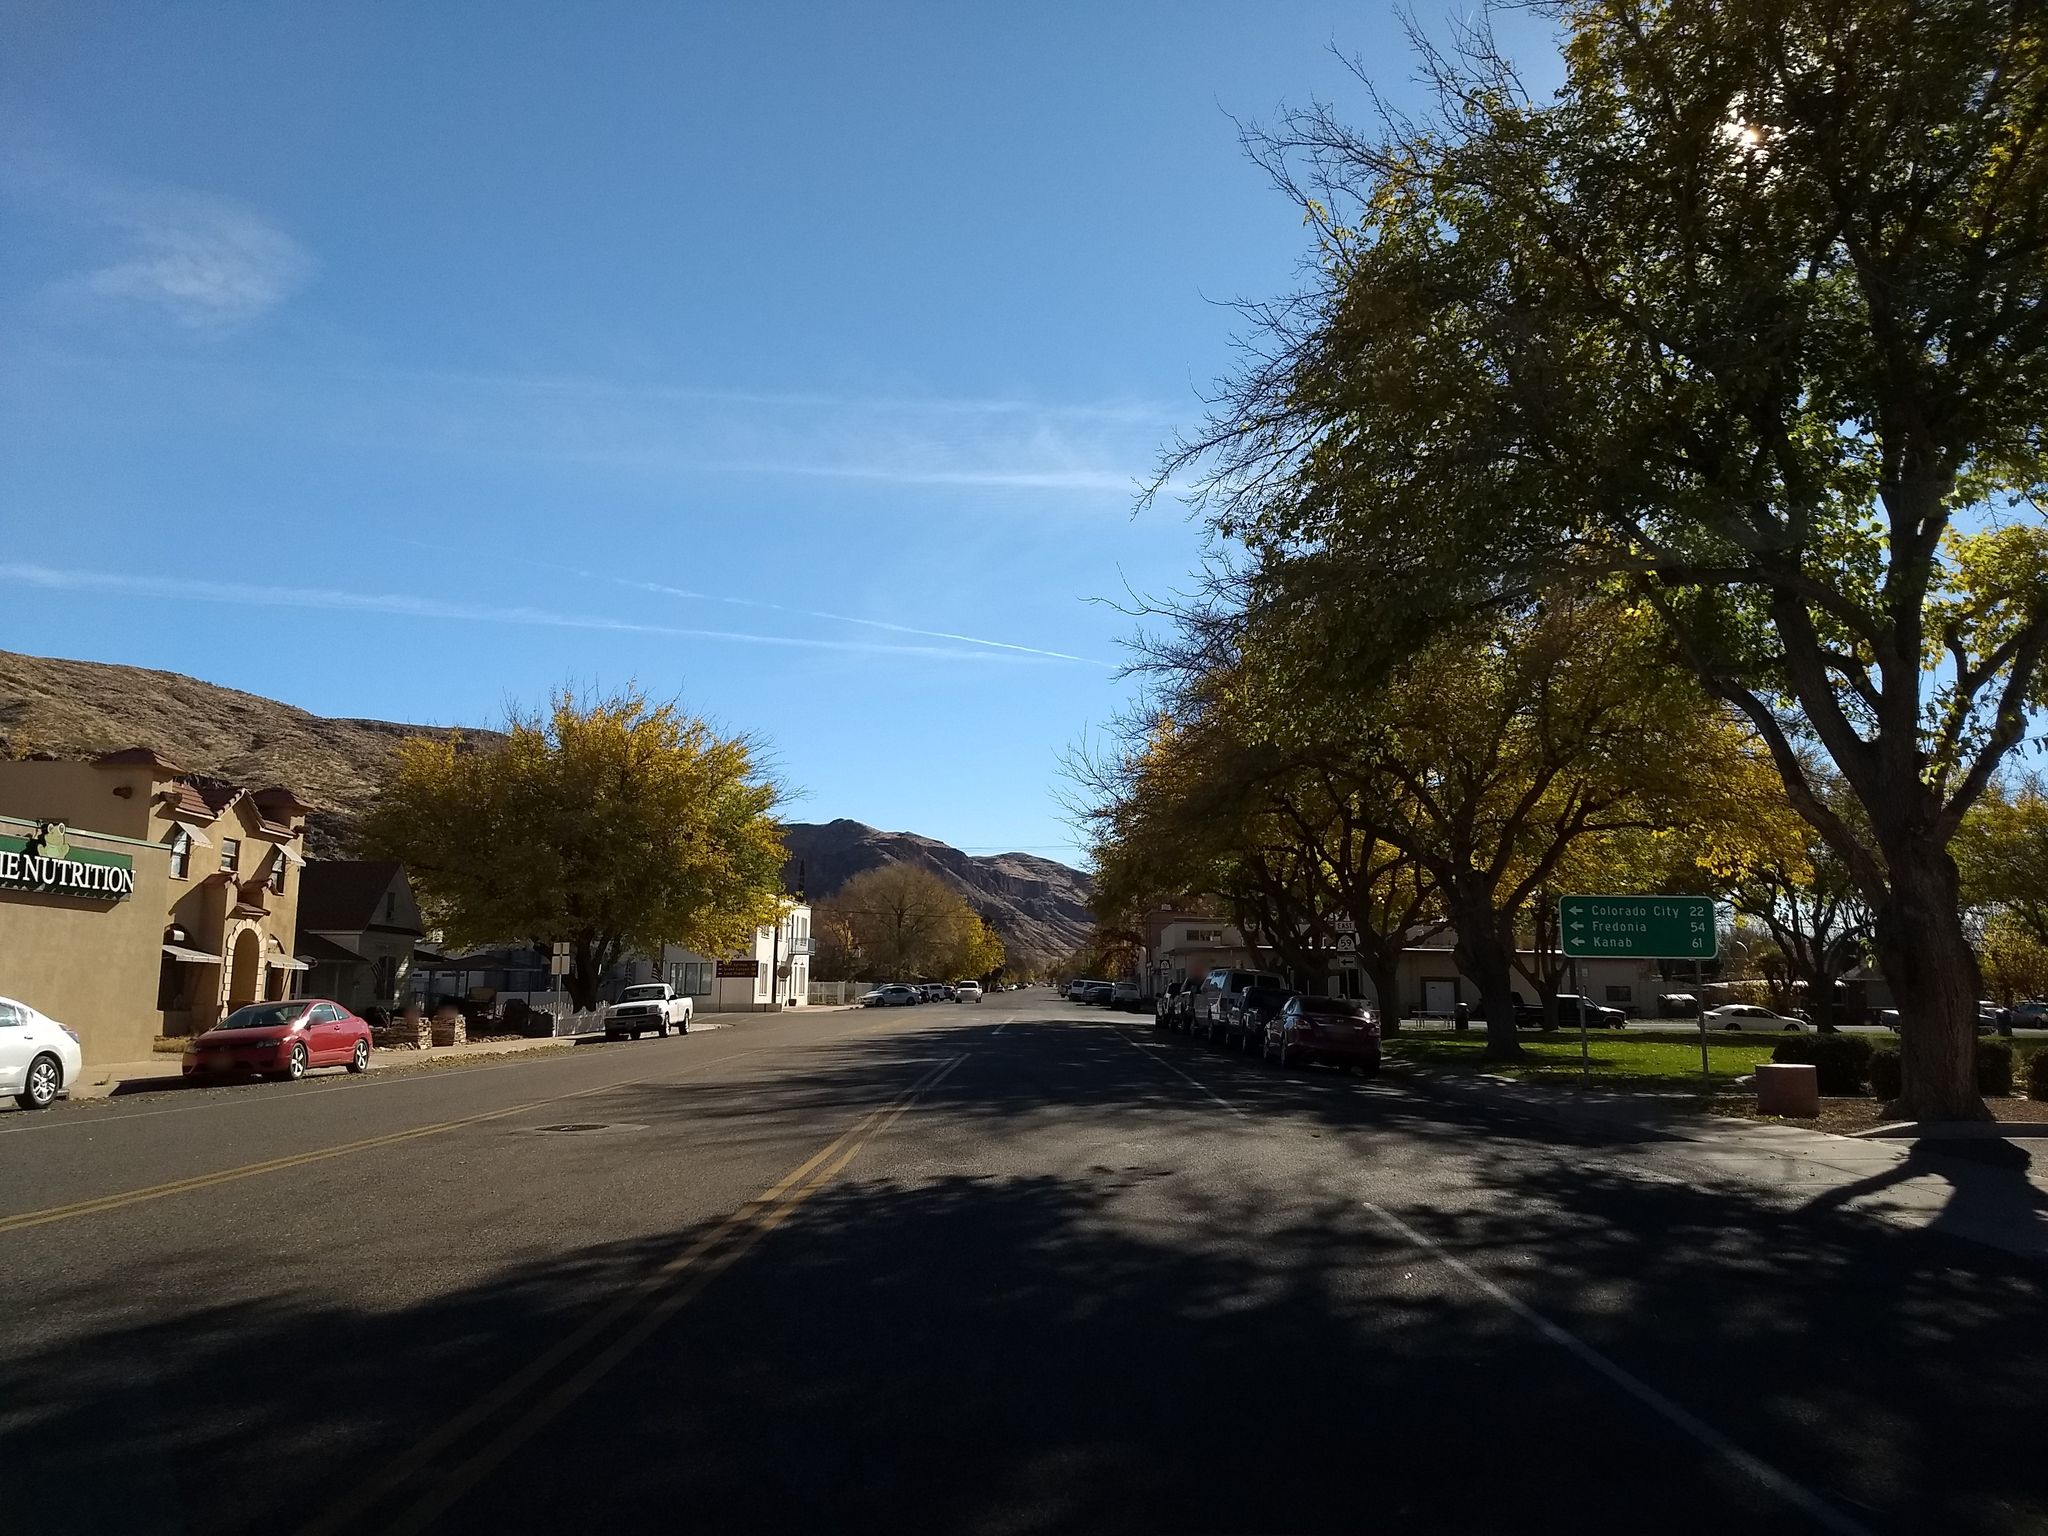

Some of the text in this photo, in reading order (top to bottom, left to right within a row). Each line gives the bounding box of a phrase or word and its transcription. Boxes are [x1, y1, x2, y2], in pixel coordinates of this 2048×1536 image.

[23, 854, 136, 893] NUTRITION
[1592, 905, 1704, 919] Colorado City 22
[1592, 921, 1705, 933] Fredonia 54
[1341, 939, 1351, 948] 59
[1593, 937, 1702, 948] Kanab 61
